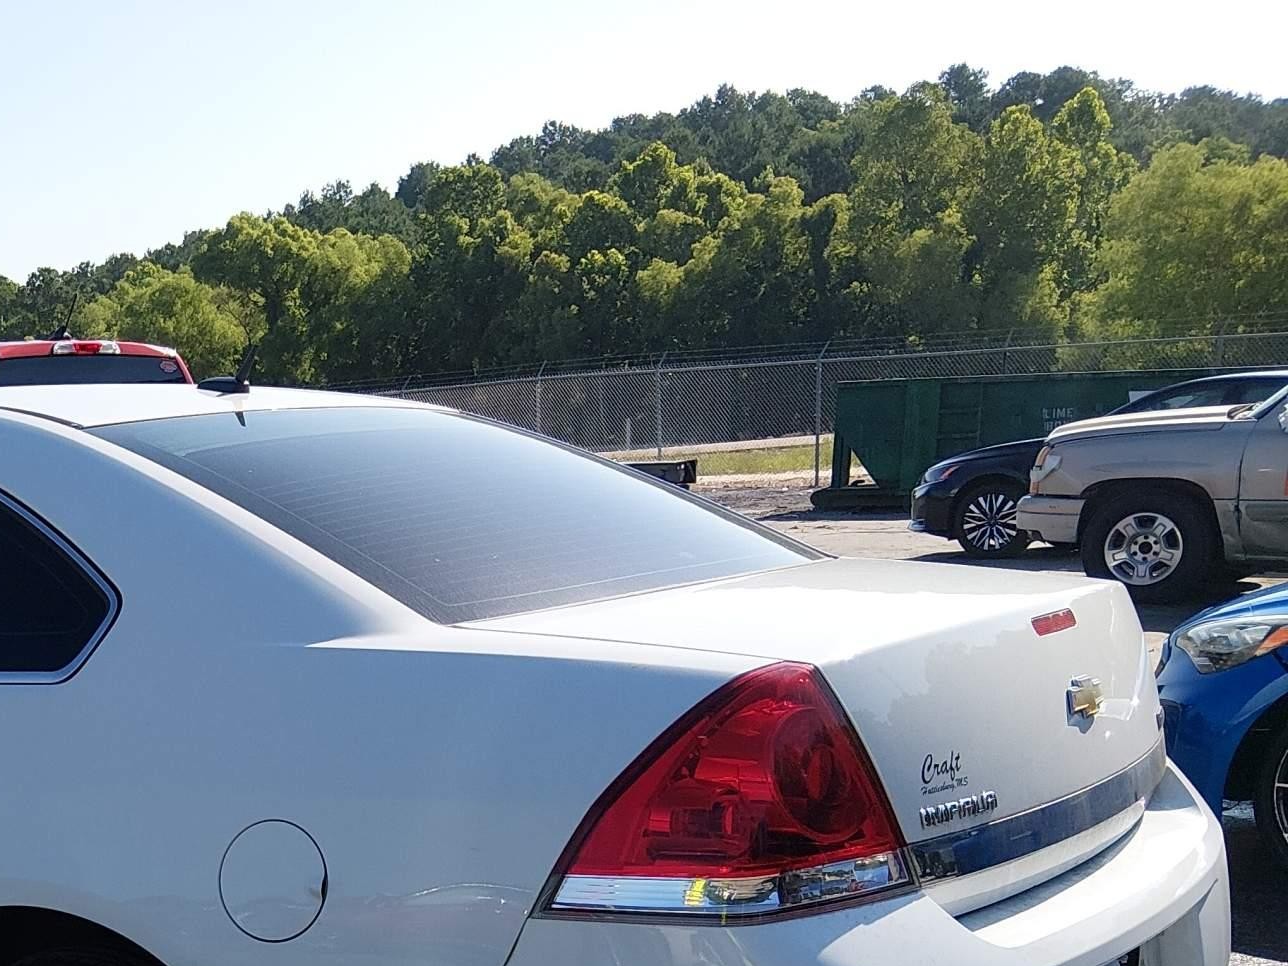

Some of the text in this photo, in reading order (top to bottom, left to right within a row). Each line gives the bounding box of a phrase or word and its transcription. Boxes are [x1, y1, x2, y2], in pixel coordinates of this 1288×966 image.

[1042, 407, 1074, 419] LIME
[1043, 420, 1067, 433] BO
[921, 750, 962, 784] Craft
